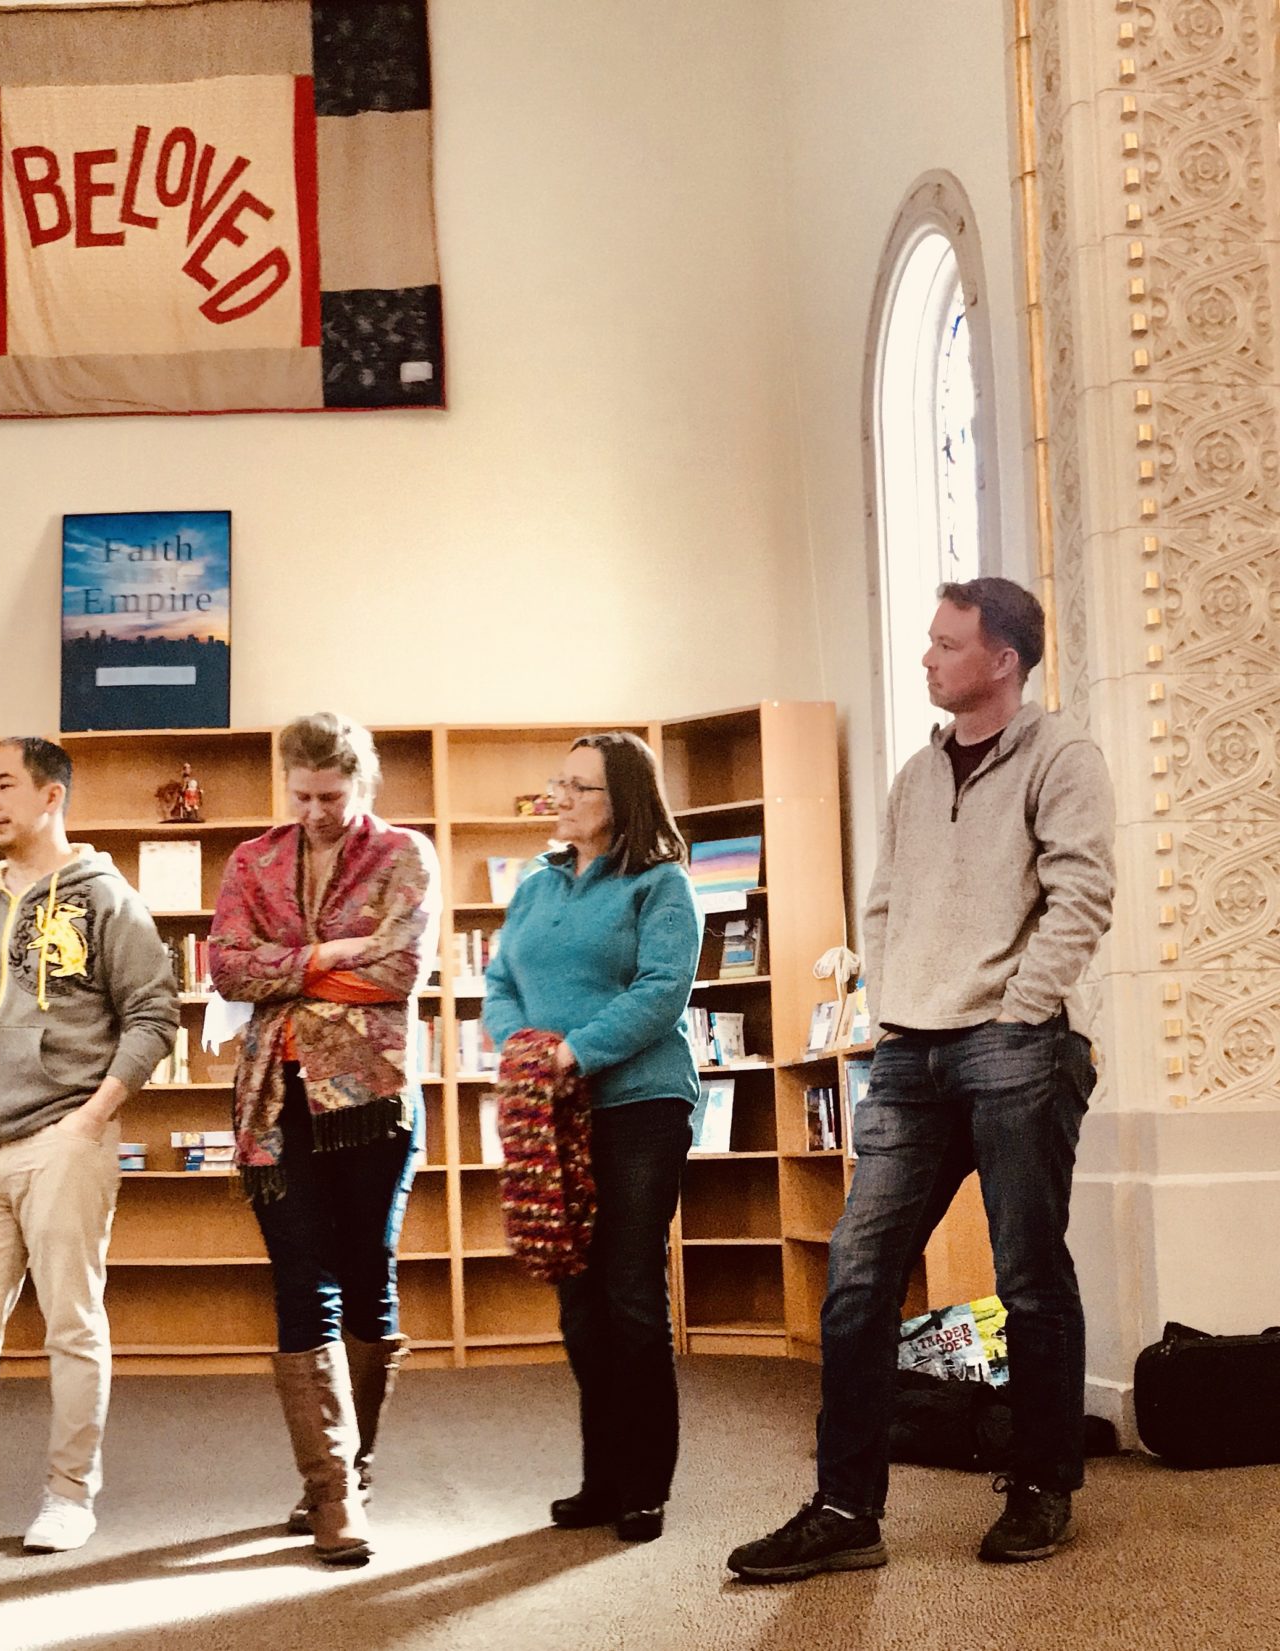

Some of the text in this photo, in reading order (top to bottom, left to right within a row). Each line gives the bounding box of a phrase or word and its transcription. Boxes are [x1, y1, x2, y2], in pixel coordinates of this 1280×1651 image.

[11, 125, 291, 324] BELOVED
[103, 535, 193, 563] Faith
[83, 587, 212, 620] Empire
[917, 1323, 972, 1350] TRADER
[938, 1335, 973, 1355] JOE'S
